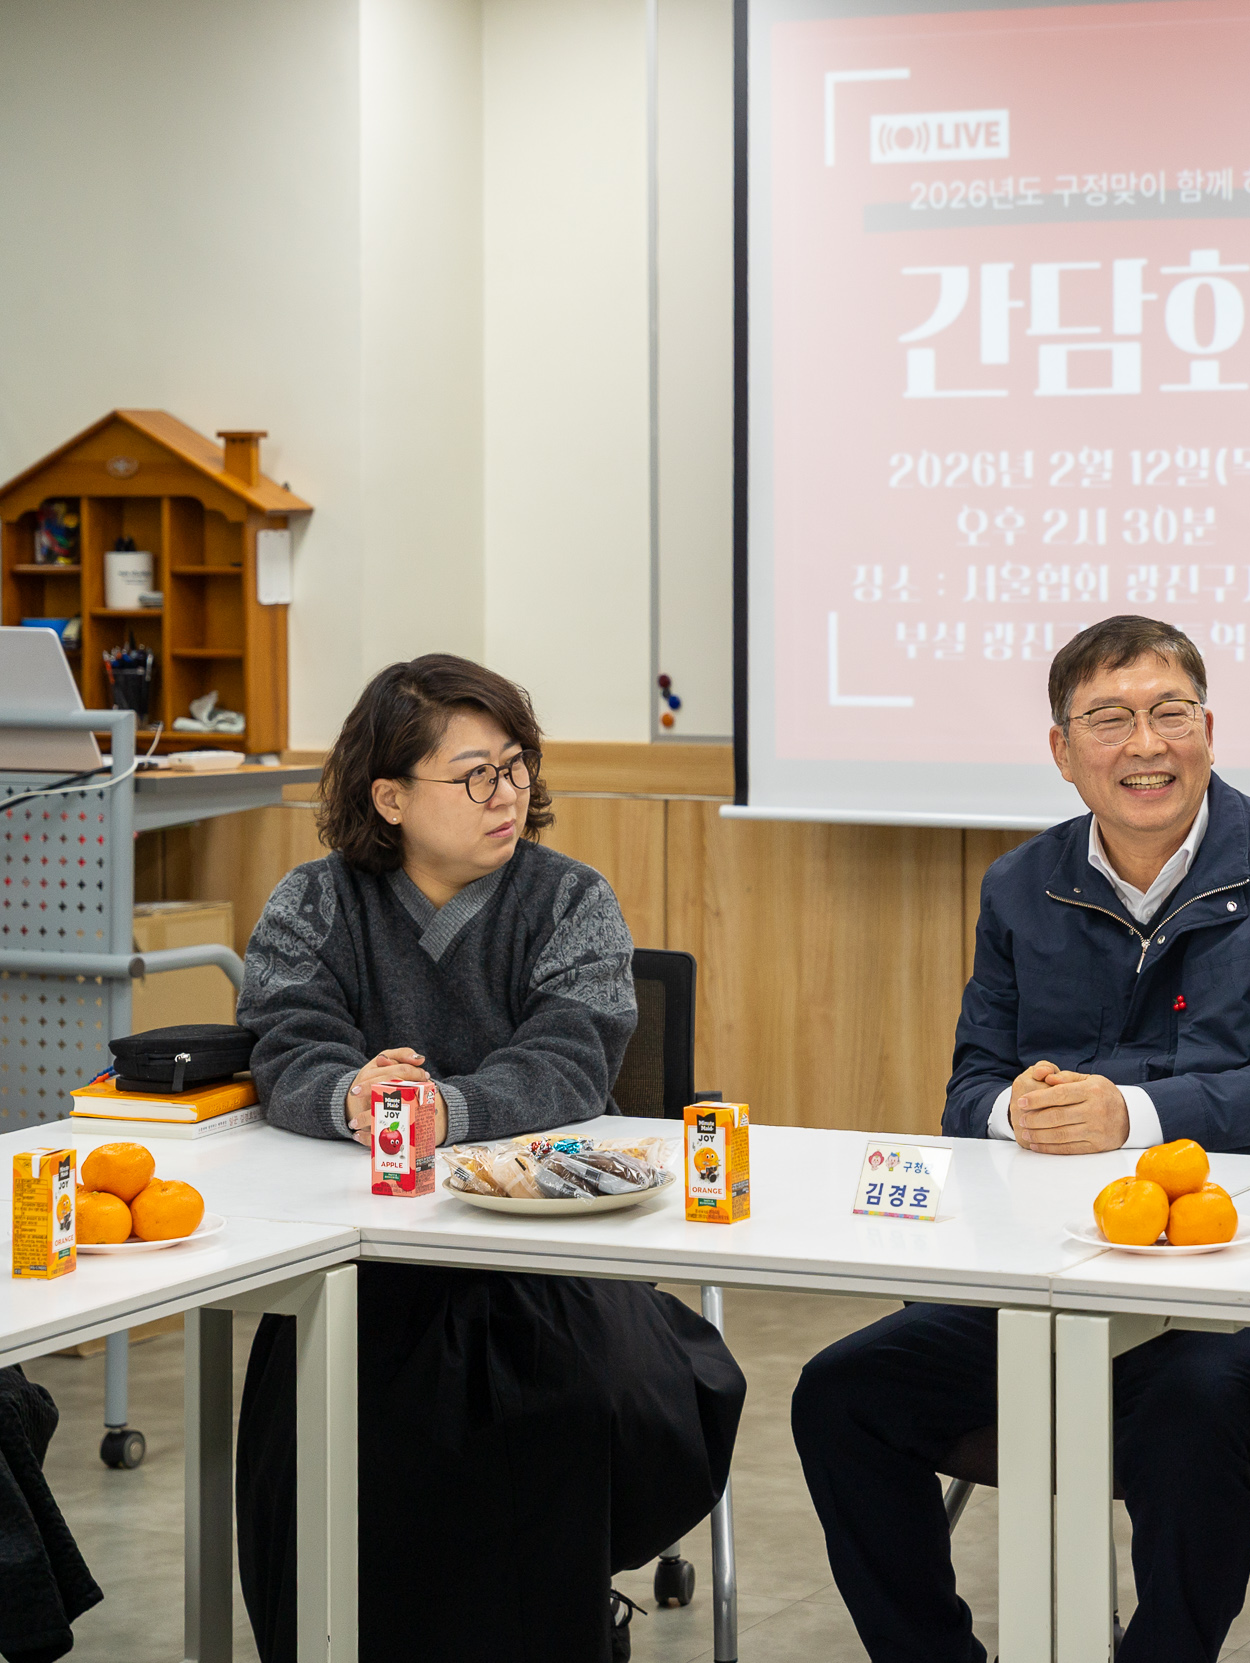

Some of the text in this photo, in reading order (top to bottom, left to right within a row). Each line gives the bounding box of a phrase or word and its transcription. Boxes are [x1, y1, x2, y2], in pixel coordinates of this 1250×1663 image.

[935, 120, 1001, 150] LIVE
[909, 175, 1044, 211] 2026년도
[1052, 169, 1167, 208] 구정맞이
[1177, 167, 1234, 203] 함께
[888, 448, 1034, 488] 2026년
[1049, 447, 1114, 488] 2월
[955, 505, 1218, 546] 오후 2시 30분
[850, 563, 921, 602] 장소
[963, 562, 1109, 603] 서울협회
[895, 621, 967, 661] 부설
[384, 1111, 401, 1119] JOY
[698, 1134, 715, 1143] JOY
[381, 1161, 404, 1169] APPLE
[58, 1180, 69, 1190] JOY
[692, 1186, 723, 1195] ORANGE
[865, 1182, 931, 1208] 김경호
[54, 1234, 74, 1247] ORANGE
